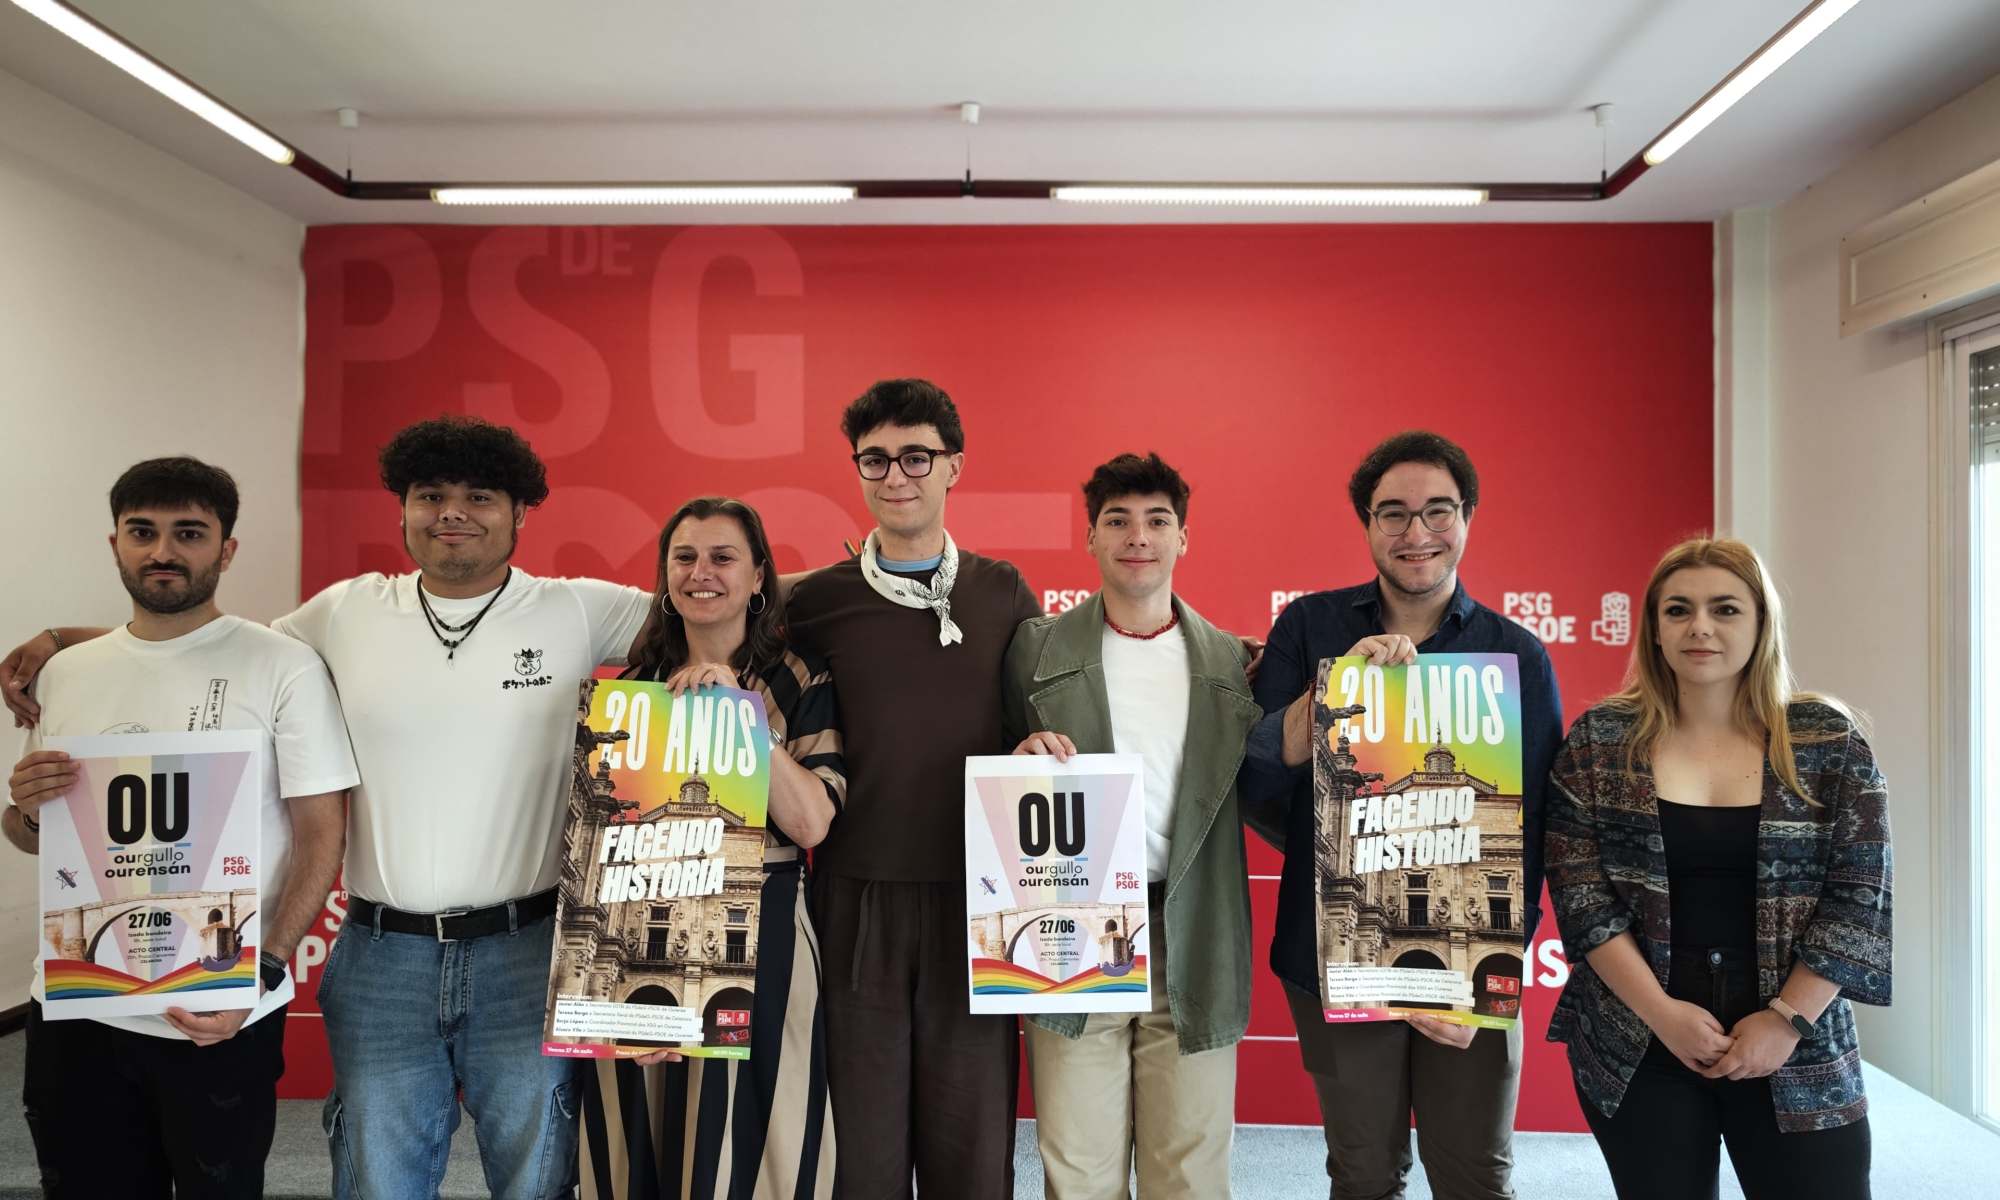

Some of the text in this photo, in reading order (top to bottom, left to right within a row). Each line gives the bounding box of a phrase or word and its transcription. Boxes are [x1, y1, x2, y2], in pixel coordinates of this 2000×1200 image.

[1340, 664, 1505, 745] 20 ANOS
[601, 690, 757, 777] 20 ANOS
[107, 772, 189, 845] OU
[1018, 792, 1086, 857] OU
[1350, 786, 1476, 836] FACENDO
[114, 847, 184, 866] ourgullo
[599, 818, 725, 864] FACENDO
[1354, 826, 1481, 875] HISTORIA
[105, 862, 191, 878] ourensán
[223, 865, 251, 876] PSOE
[599, 858, 726, 904] HISTORIA
[1019, 874, 1089, 887] ourensán
[1026, 861, 1083, 878] ourgullo
[1116, 880, 1140, 890] PSOE
[128, 911, 172, 929] 27/06
[1040, 919, 1075, 934] 27/06
